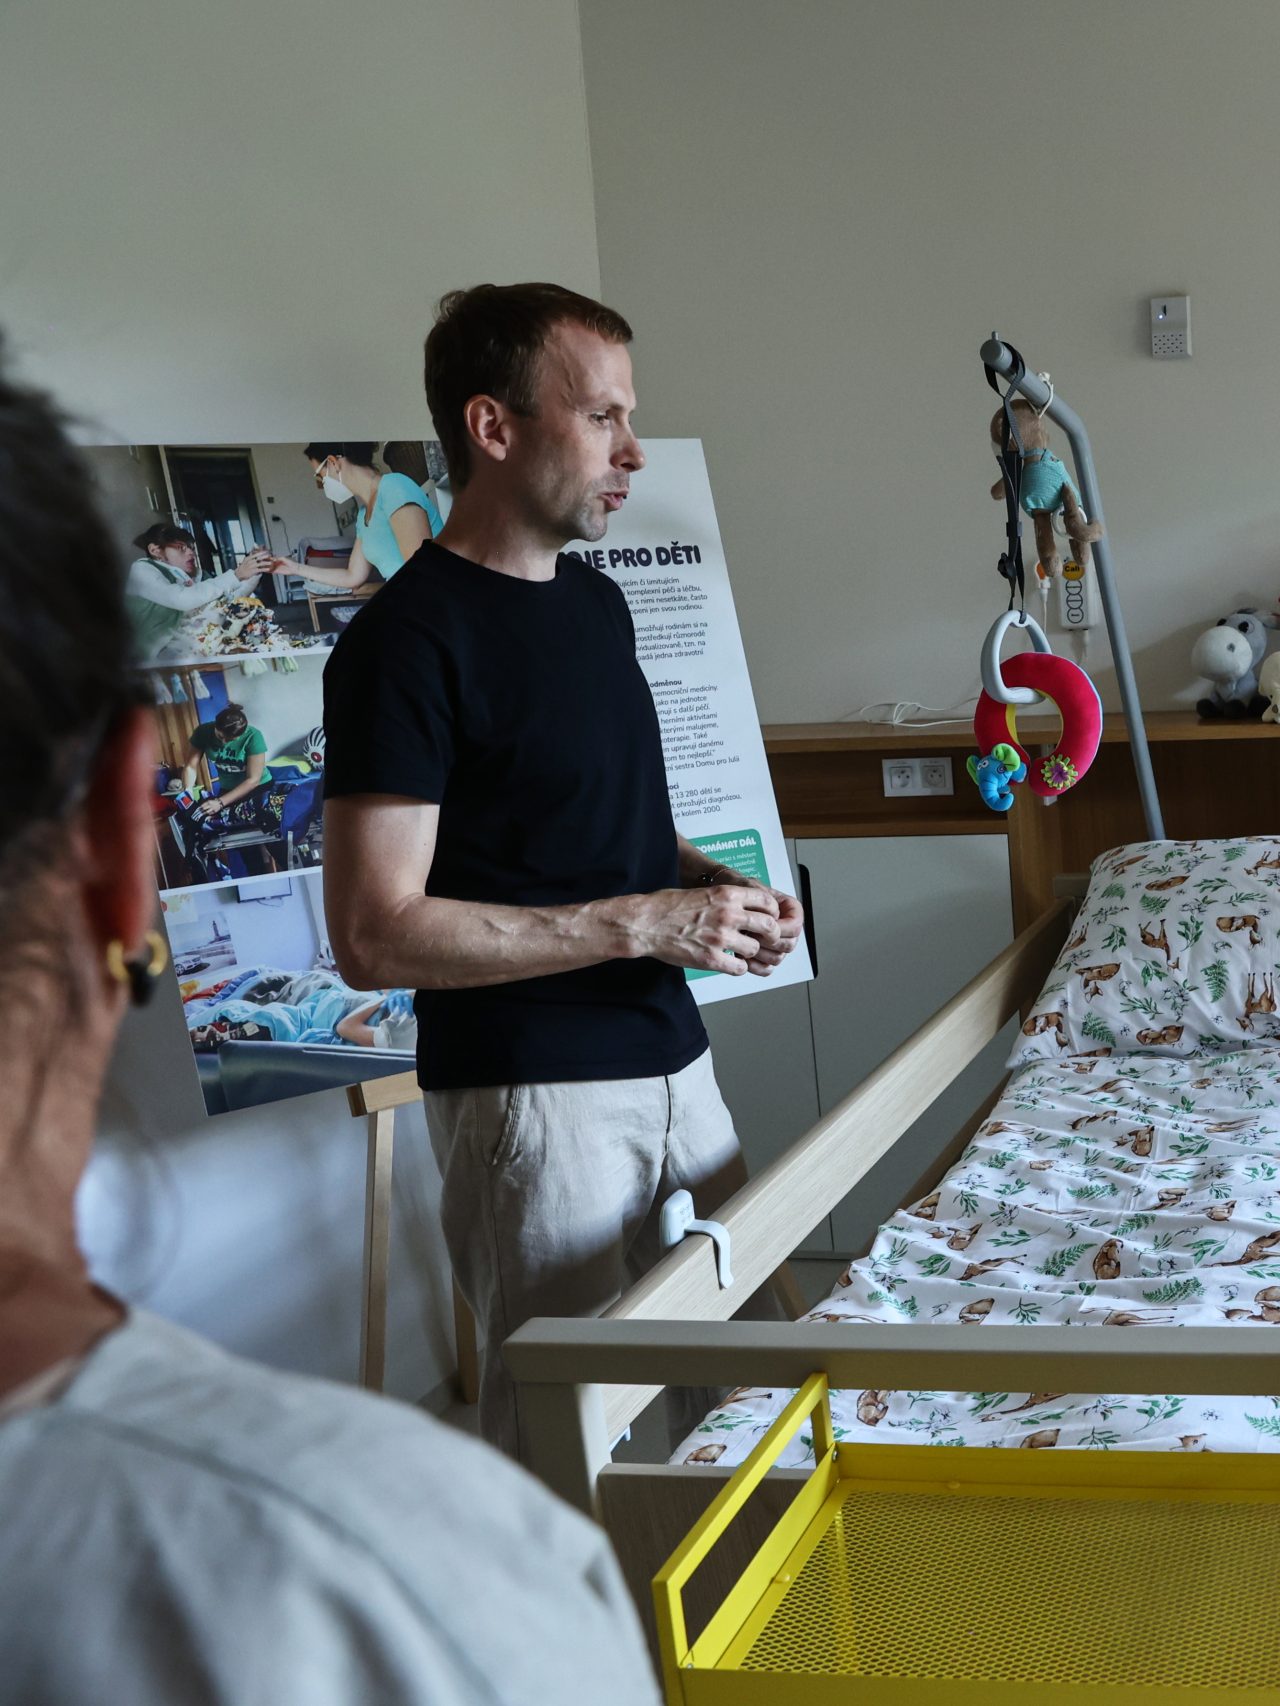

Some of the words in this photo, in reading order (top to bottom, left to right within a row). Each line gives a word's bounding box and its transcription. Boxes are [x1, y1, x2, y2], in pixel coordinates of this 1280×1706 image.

[608, 548, 652, 568] PRO
[655, 541, 701, 566] DĚTI
[627, 587, 660, 596] komplexní
[666, 621, 691, 630] rodinám
[636, 641, 683, 651] vidualizovaně,
[655, 652, 673, 660] jedna
[674, 648, 703, 657] zdravotní
[680, 695, 707, 705] jednotce
[679, 705, 694, 713] další
[687, 712, 718, 721] aktivitami
[693, 731, 708, 740] Také
[671, 743, 697, 752] upravují
[698, 740, 724, 749] danému
[675, 763, 694, 771] sestra
[695, 760, 715, 768] Domu
[717, 758, 727, 766] pro
[681, 809, 701, 817] kolem
[739, 835, 757, 847] DÁL
